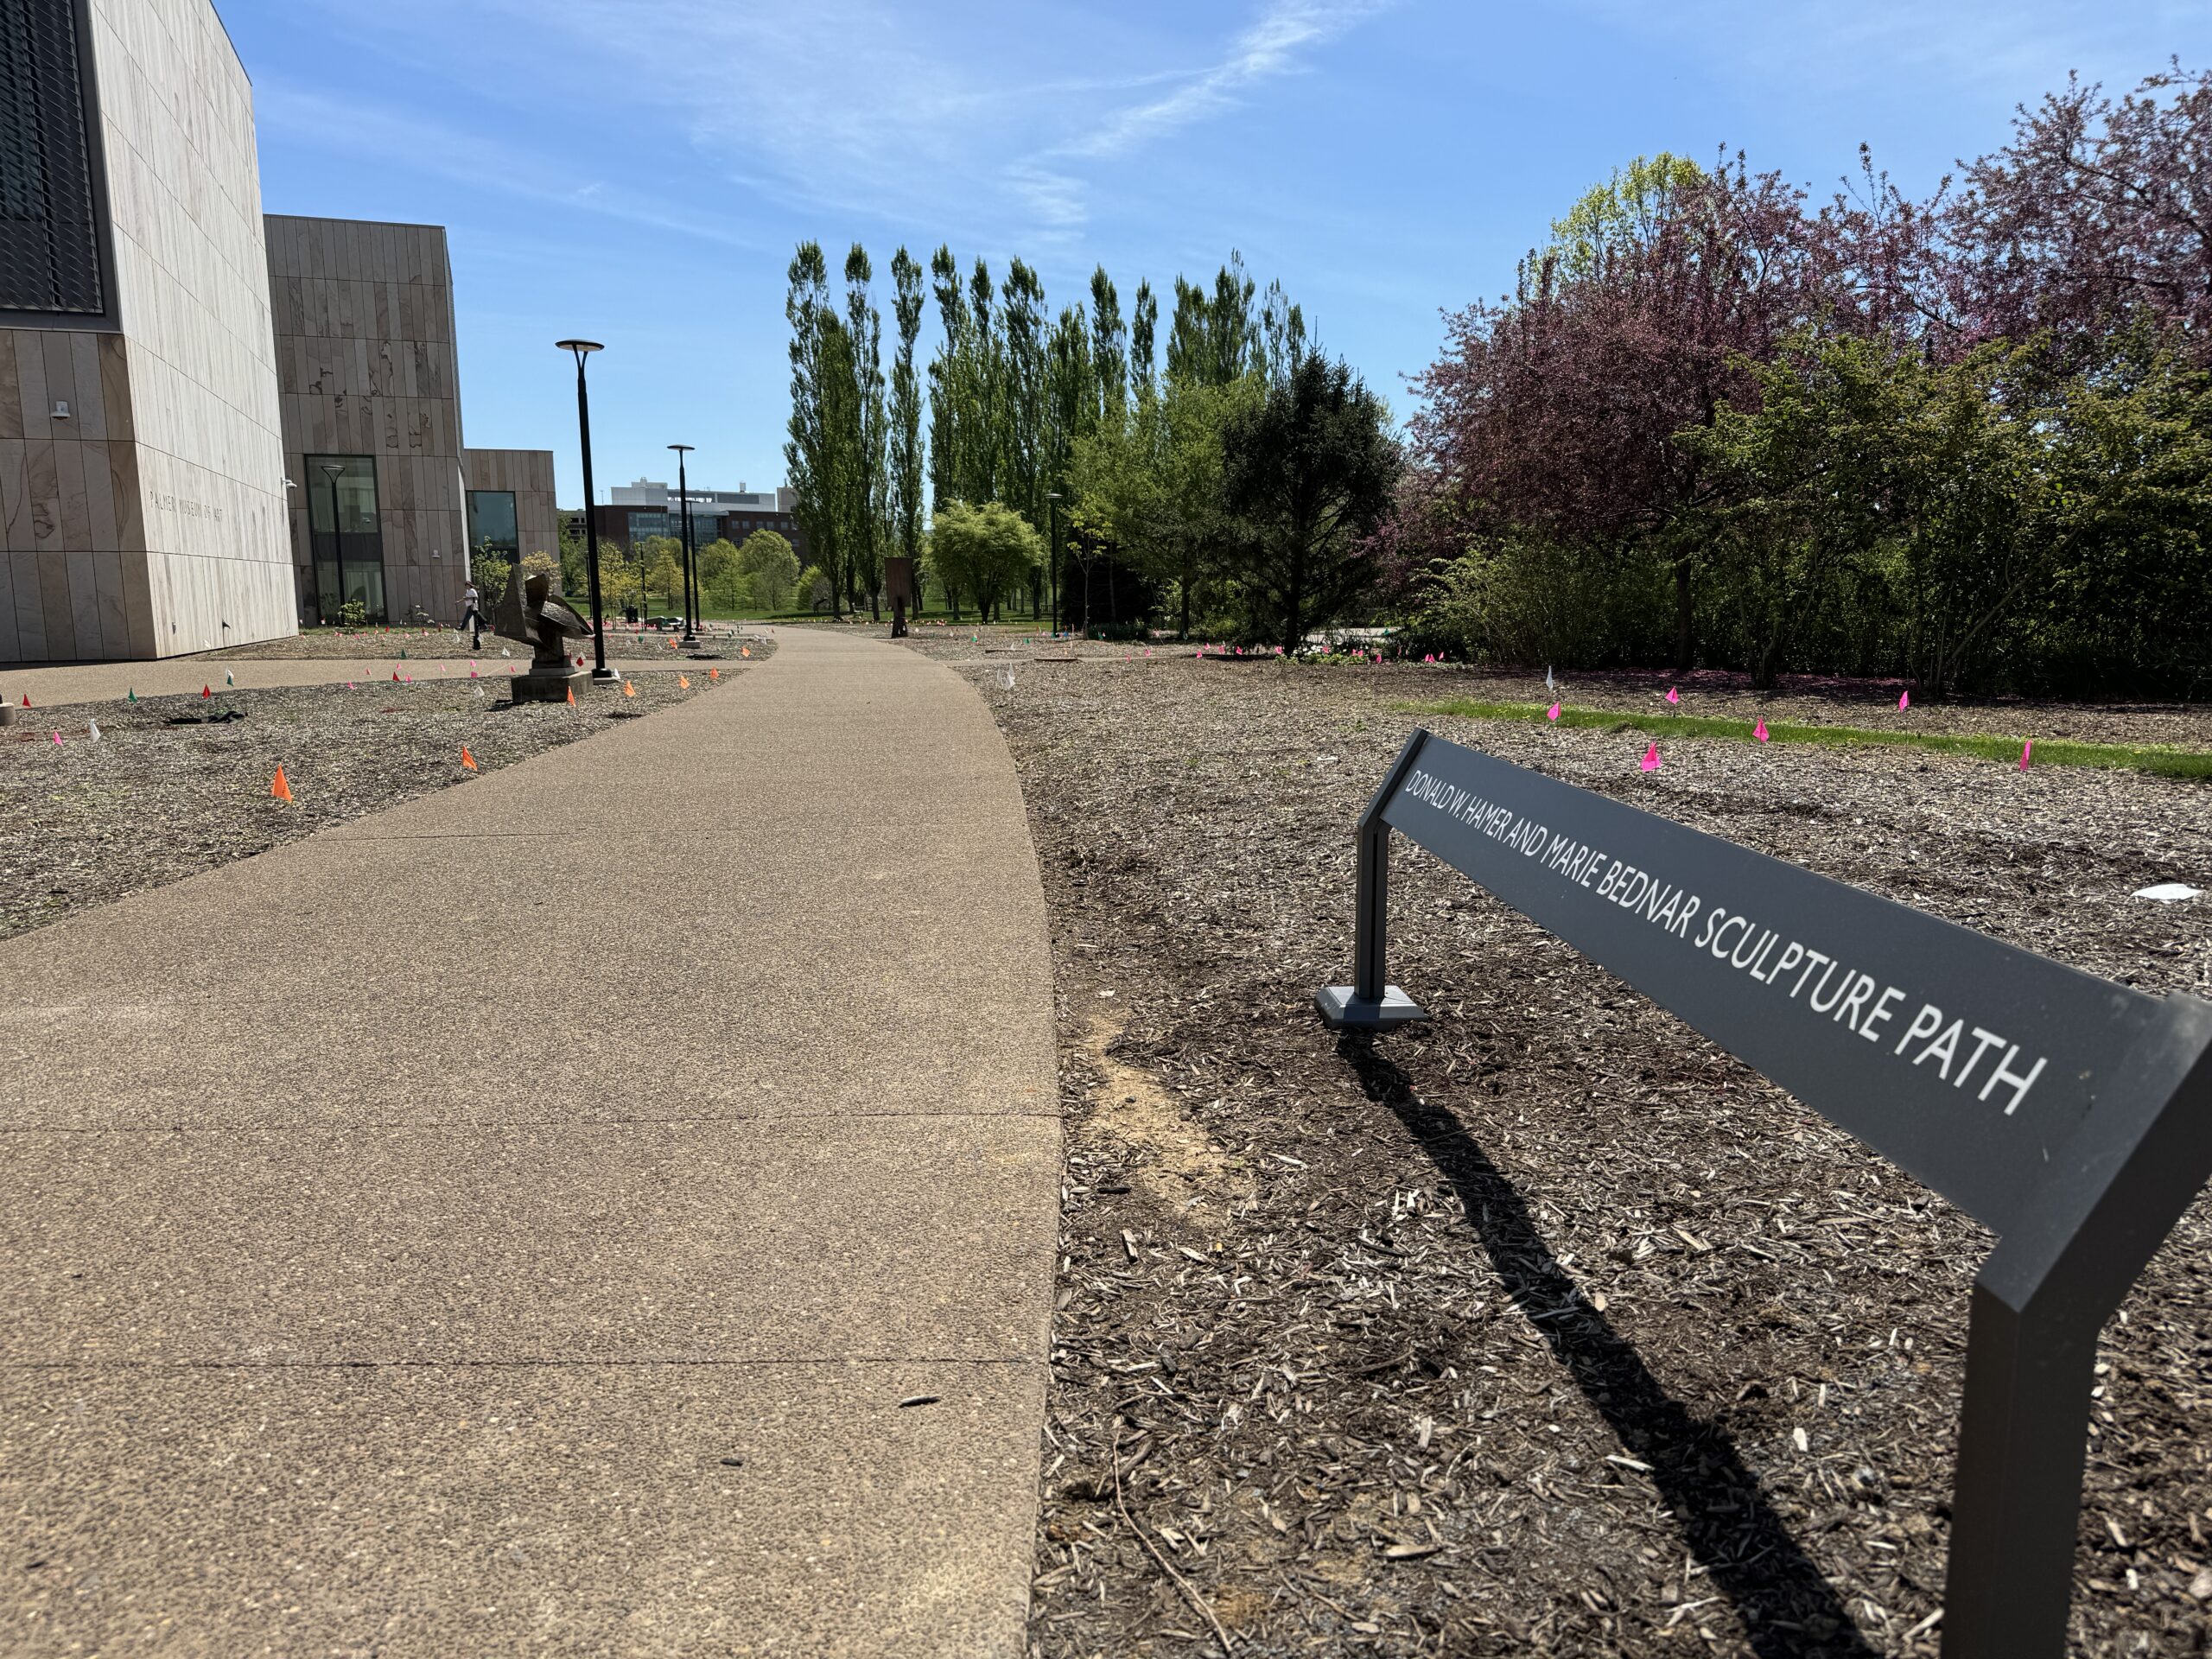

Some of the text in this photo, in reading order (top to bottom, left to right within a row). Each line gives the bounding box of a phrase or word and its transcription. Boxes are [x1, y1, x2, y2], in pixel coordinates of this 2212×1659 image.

[149, 490, 177, 512] PALMER
[1404, 769, 2048, 1116] DONALD W. HAMER AND MARIE BEDNAR SCULPTURE PATH
